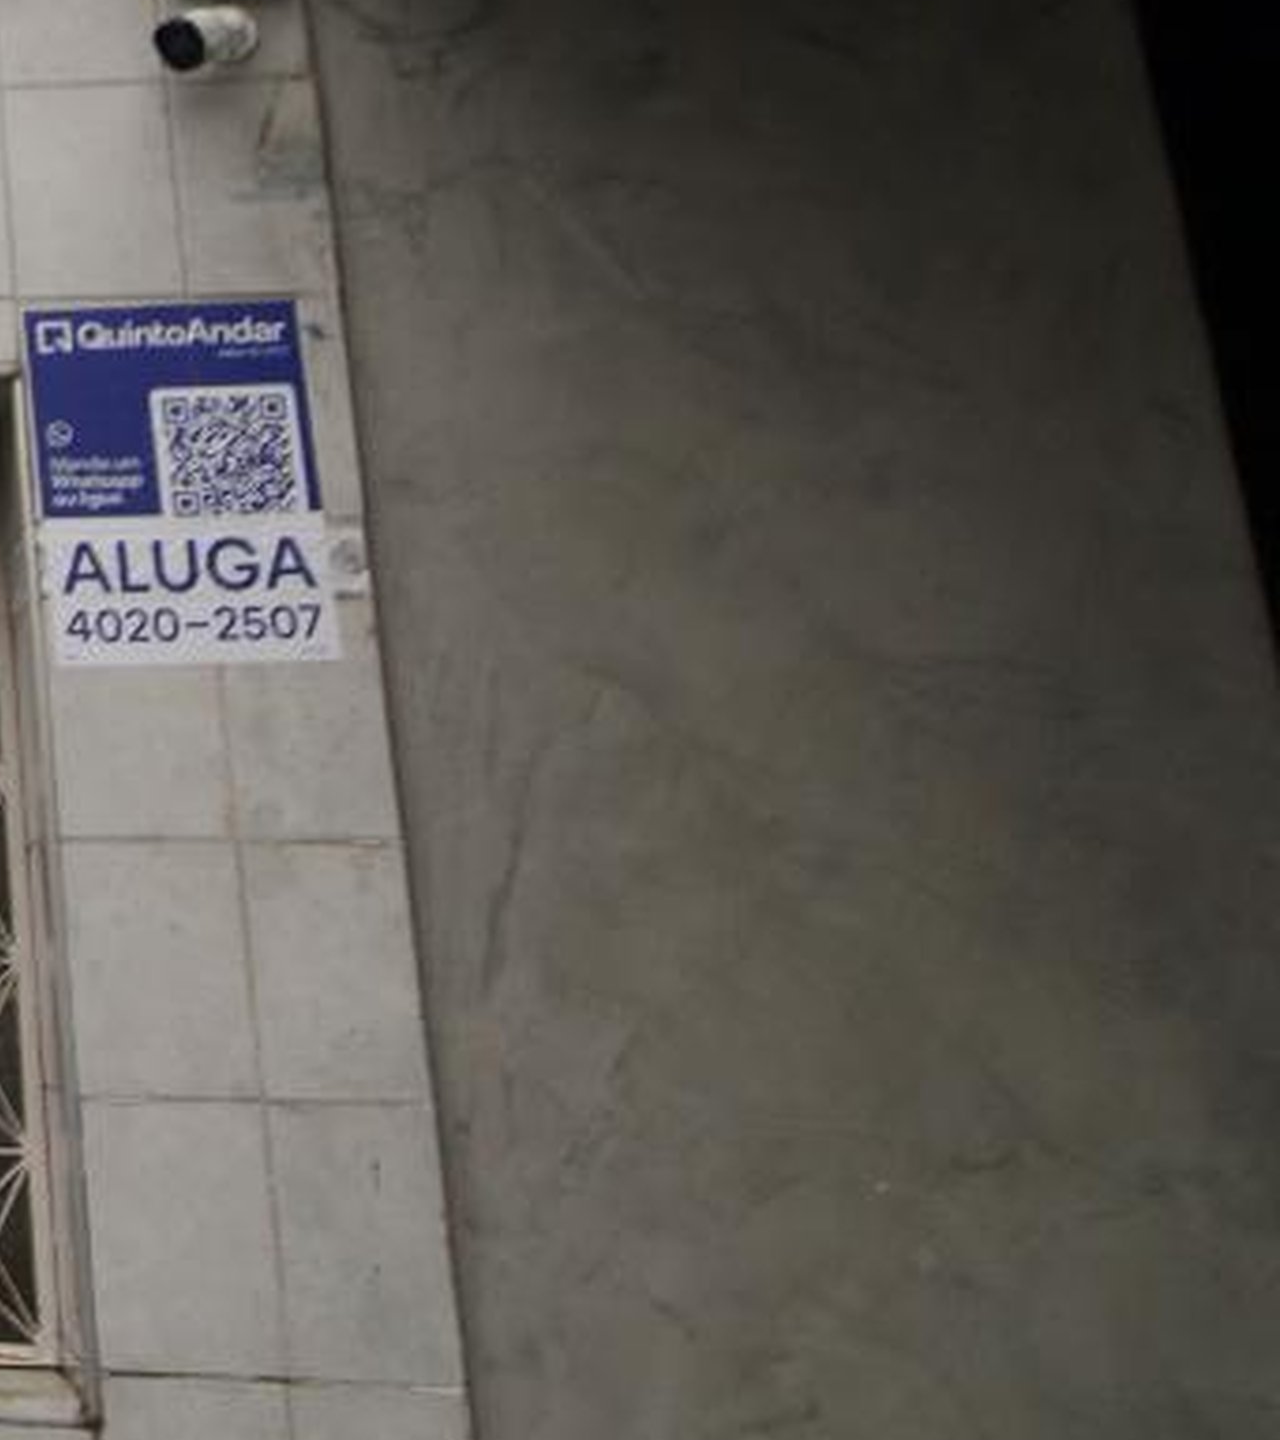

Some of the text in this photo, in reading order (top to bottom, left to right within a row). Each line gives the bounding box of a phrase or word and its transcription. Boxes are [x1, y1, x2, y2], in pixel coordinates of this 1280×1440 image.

[78, 317, 285, 350] QuintoAndar
[65, 538, 318, 595] ALUGA
[65, 605, 322, 643] 4020-2507
